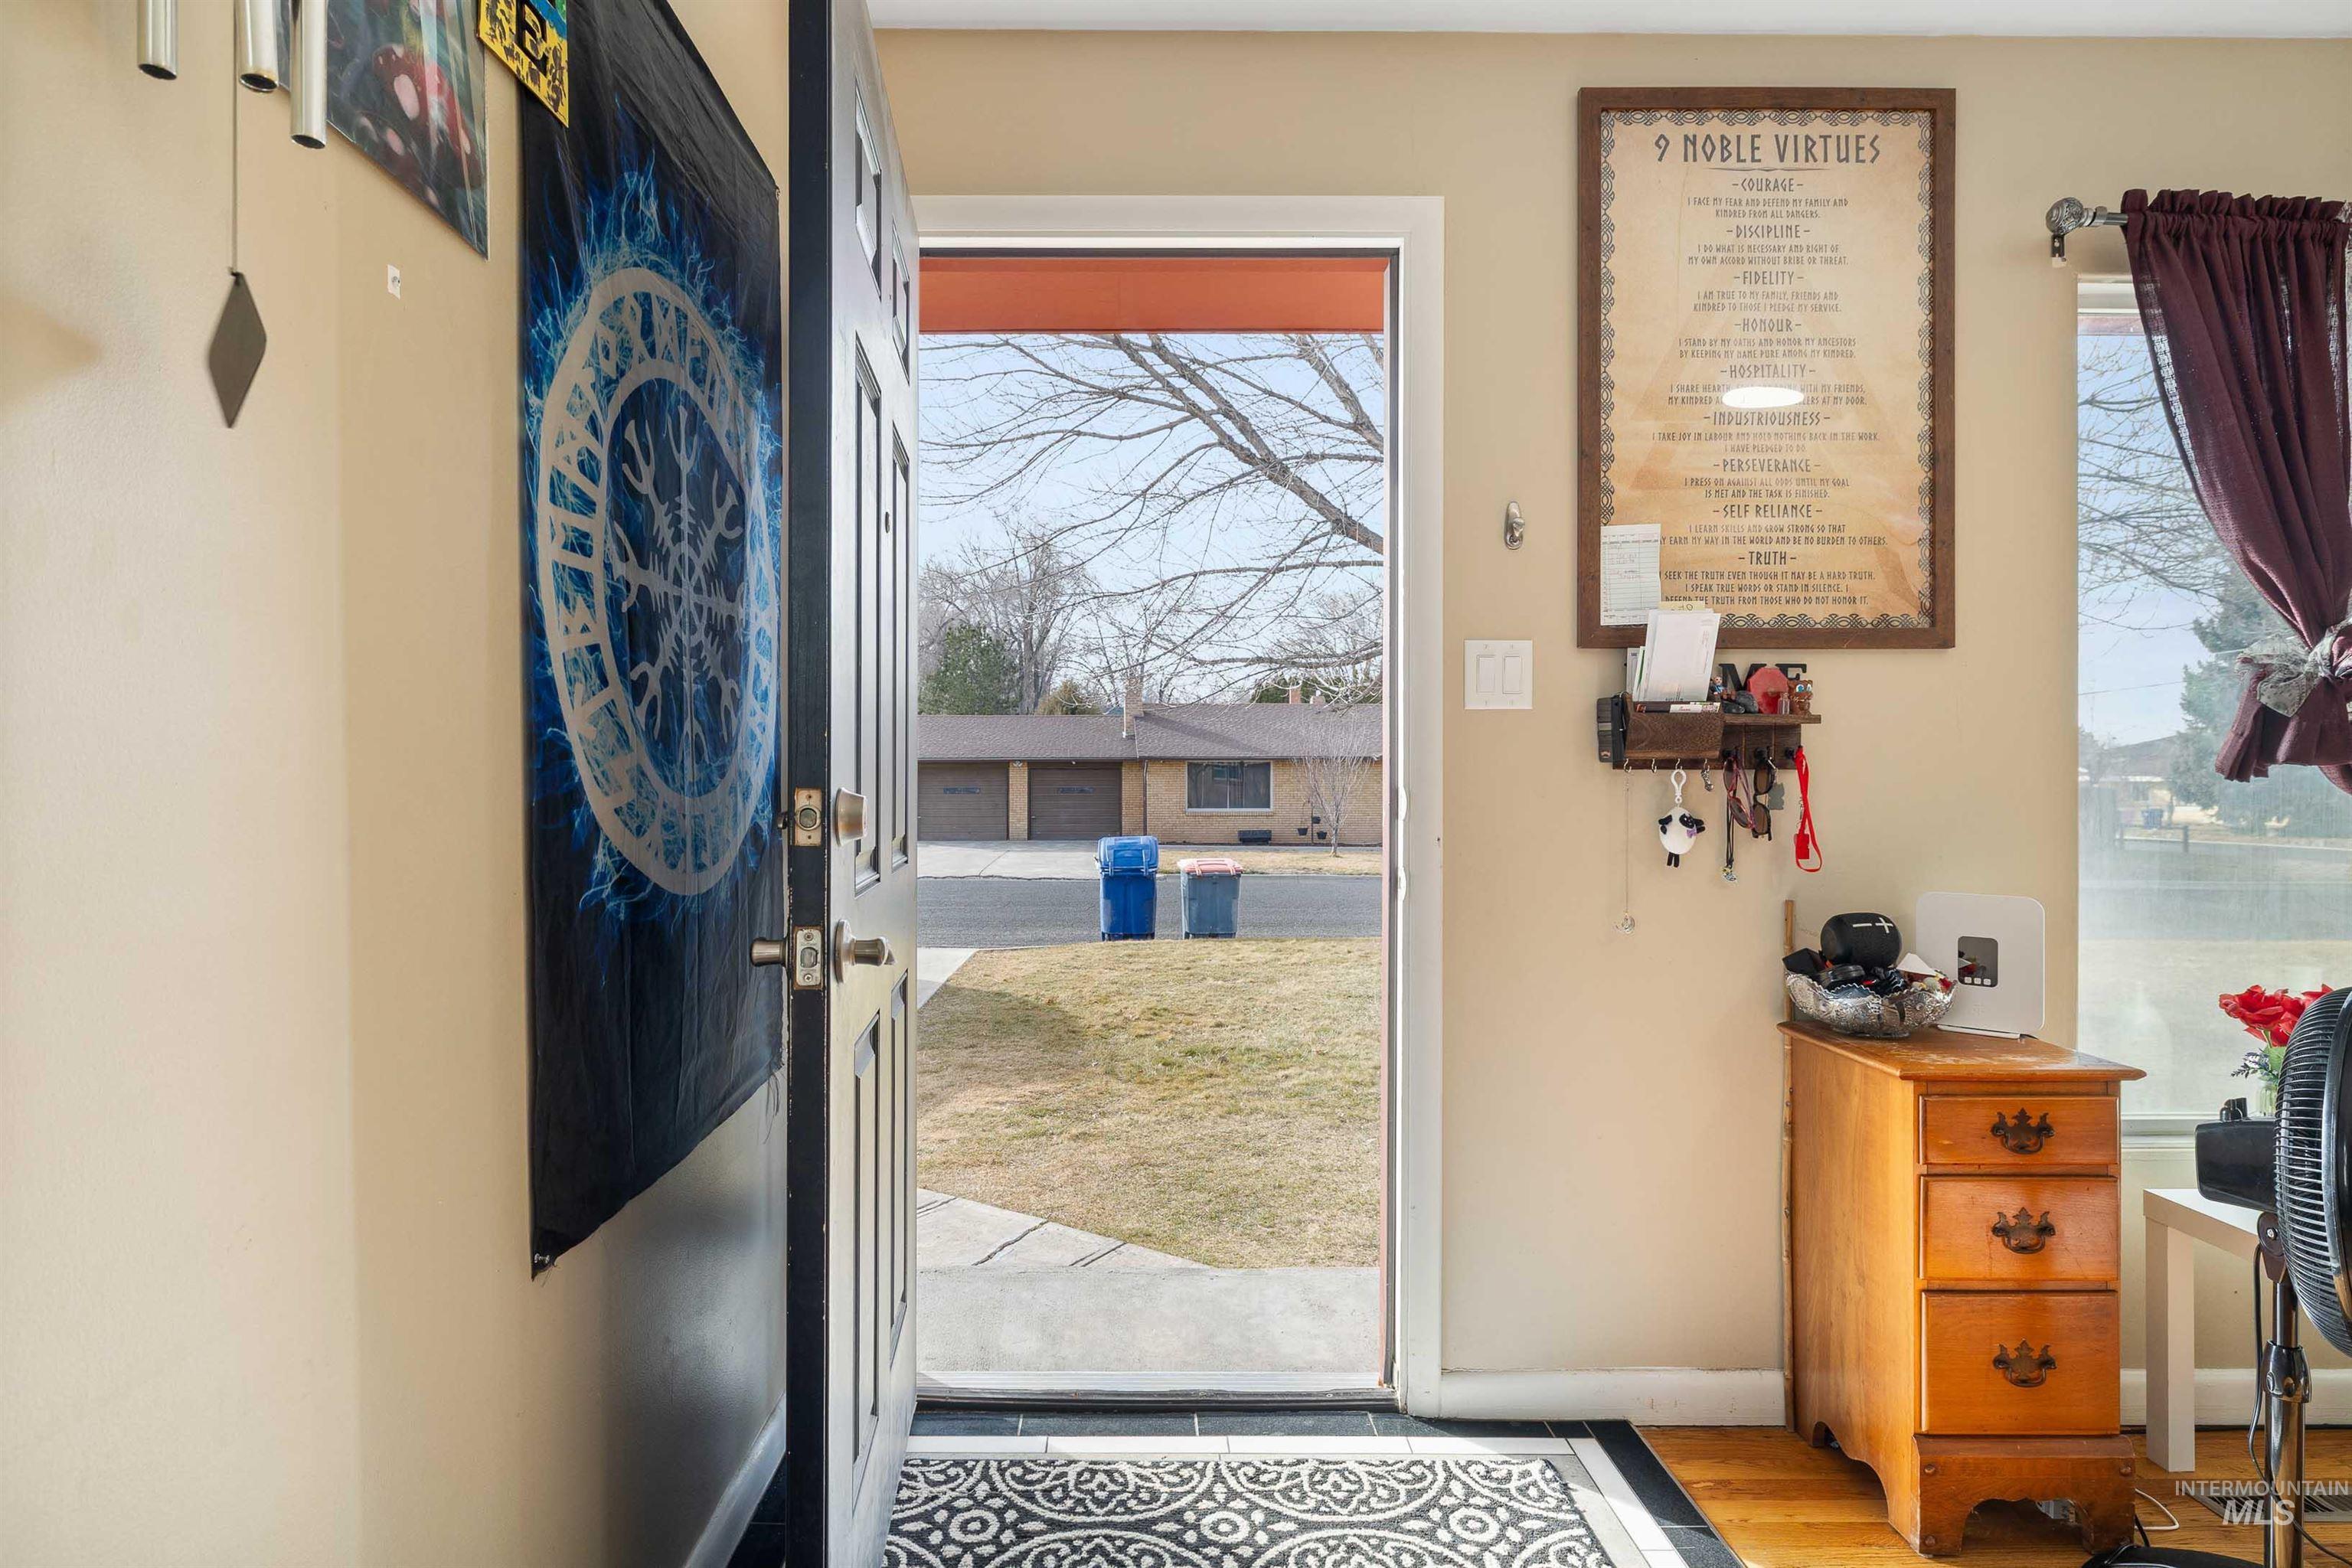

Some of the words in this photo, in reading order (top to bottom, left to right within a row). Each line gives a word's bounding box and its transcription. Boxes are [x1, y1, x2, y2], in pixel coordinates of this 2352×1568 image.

[1654, 134, 1671, 164] 9
[1683, 134, 1762, 164] NOBLE
[1775, 134, 1880, 164] VIRTUES
[1693, 197, 1710, 207] FACE
[1713, 197, 1723, 207] MY
[1725, 197, 1743, 207] FEAR
[1745, 197, 1761, 207] AND
[1762, 197, 1790, 207] DEFEND
[1792, 197, 1802, 207] MY
[1805, 197, 1831, 207] FAMILY
[1833, 197, 1848, 207] AND
[1715, 209, 1747, 219] KINDRED
[1749, 209, 1768, 219] FROM
[1770, 209, 1783, 219] ALL
[1704, 243, 1713, 254] DO
[1715, 243, 1735, 254] WHAT
[1737, 243, 1745, 254] IS
[1747, 243, 1786, 254] NECESSARY
[1788, 243, 1804, 254] AND
[1806, 243, 1828, 254] RIGHT
[1830, 243, 1839, 254] OF
[1688, 256, 1699, 266] MY
[1700, 256, 1717, 266] OWN
[1720, 256, 1746, 266] ACCORD
[1747, 256, 1780, 266] WITHOUT
[1783, 256, 1805, 266] BRIBE
[1807, 256, 1817, 266] OR
[1703, 290, 1713, 302] AM
[1717, 290, 1736, 302] TRUE
[1738, 290, 1747, 302] TO
[1749, 290, 1759, 302] MY
[1791, 290, 1821, 302] FRIENDS
[1823, 290, 1839, 302] AND
[1693, 302, 1726, 313] KINDRED
[1728, 302, 1737, 313] TO
[1798, 302, 1808, 313] MY
[1684, 337, 1707, 348] STAND
[1709, 337, 1718, 348] BY
[1720, 337, 1731, 348] MY
[1758, 337, 1774, 348] AND
[1776, 337, 1802, 348] HONOR
[1805, 337, 1815, 348] MY
[1818, 337, 1856, 348] ANCESTORS
[1679, 348, 1689, 359] BY
[1690, 348, 1721, 359] KEEPING
[1723, 348, 1735, 359] MY
[1736, 348, 1757, 359] NAME
[1759, 348, 1779, 359] PURE
[1782, 348, 1808, 359] AMONG
[1810, 348, 1821, 359] MY
[1676, 384, 1700, 394] SHARE
[1821, 384, 1831, 394] MY
[1668, 395, 1679, 406] MY
[1681, 395, 1713, 406] KINDRED
[1821, 395, 1831, 406] AT
[1832, 395, 1843, 406] MY
[1658, 432, 1676, 442] TAKE
[1678, 432, 1691, 442] JOY
[1694, 432, 1702, 442] IN
[1730, 443, 1750, 454] HAVE
[1690, 477, 1712, 488] PRESS
[1713, 477, 1724, 488] ON
[1759, 477, 1772, 488] ALL
[1819, 477, 1830, 488] MY
[1831, 477, 1849, 488] GOAL
[1705, 488, 1712, 499] IS
[1714, 488, 1729, 499] MET
[1731, 488, 1746, 499] AND
[1749, 488, 1762, 499] THE
[1766, 488, 1783, 499] TASK
[1785, 488, 1792, 499] IS
[1694, 524, 1718, 534] LEARN
[1720, 524, 1745, 534] SKILLS
[1747, 524, 1762, 534] AND
[1764, 524, 1785, 534] GROW
[1787, 524, 1815, 534] STRONG
[1817, 524, 1826, 534] SO
[1828, 524, 1846, 534] THAT
[1669, 536, 1688, 546] EARN
[1691, 536, 1702, 546] MY
[1704, 536, 1719, 546] WAY
[1721, 536, 1730, 546] IN
[1733, 536, 1746, 546] THE
[1749, 536, 1773, 546] WORLD
[1775, 536, 1791, 546] AND
[1792, 536, 1802, 546] BE
[1804, 536, 1815, 546] NO
[1816, 536, 1845, 546] BURDEN
[1848, 536, 1857, 546] TO
[1664, 570, 1682, 581] SEEK
[1685, 570, 1698, 581] THE
[1701, 570, 1725, 581] TRUTH
[1727, 570, 1746, 581] EVEN
[1749, 570, 1779, 581] THOUGH
[1781, 570, 1788, 581] IT
[1791, 570, 1805, 581] MAY
[1808, 570, 1817, 581] BE
[1819, 570, 1824, 581] A
[1827, 570, 1847, 581] HARD
[1690, 583, 1713, 593] SPEAK
[1717, 583, 1735, 593] TRUE
[1737, 583, 1761, 593] WORDS
[1763, 583, 1773, 593] OR
[1776, 583, 1799, 593] STAND
[1801, 583, 1809, 593] IN
[1711, 596, 1735, 606] TRUTH
[1738, 596, 1757, 606] FROM
[1785, 596, 1802, 606] WHO
[1803, 596, 1813, 606] DO
[1815, 596, 1829, 606] NOT
[1831, 596, 1857, 606] HONOR
